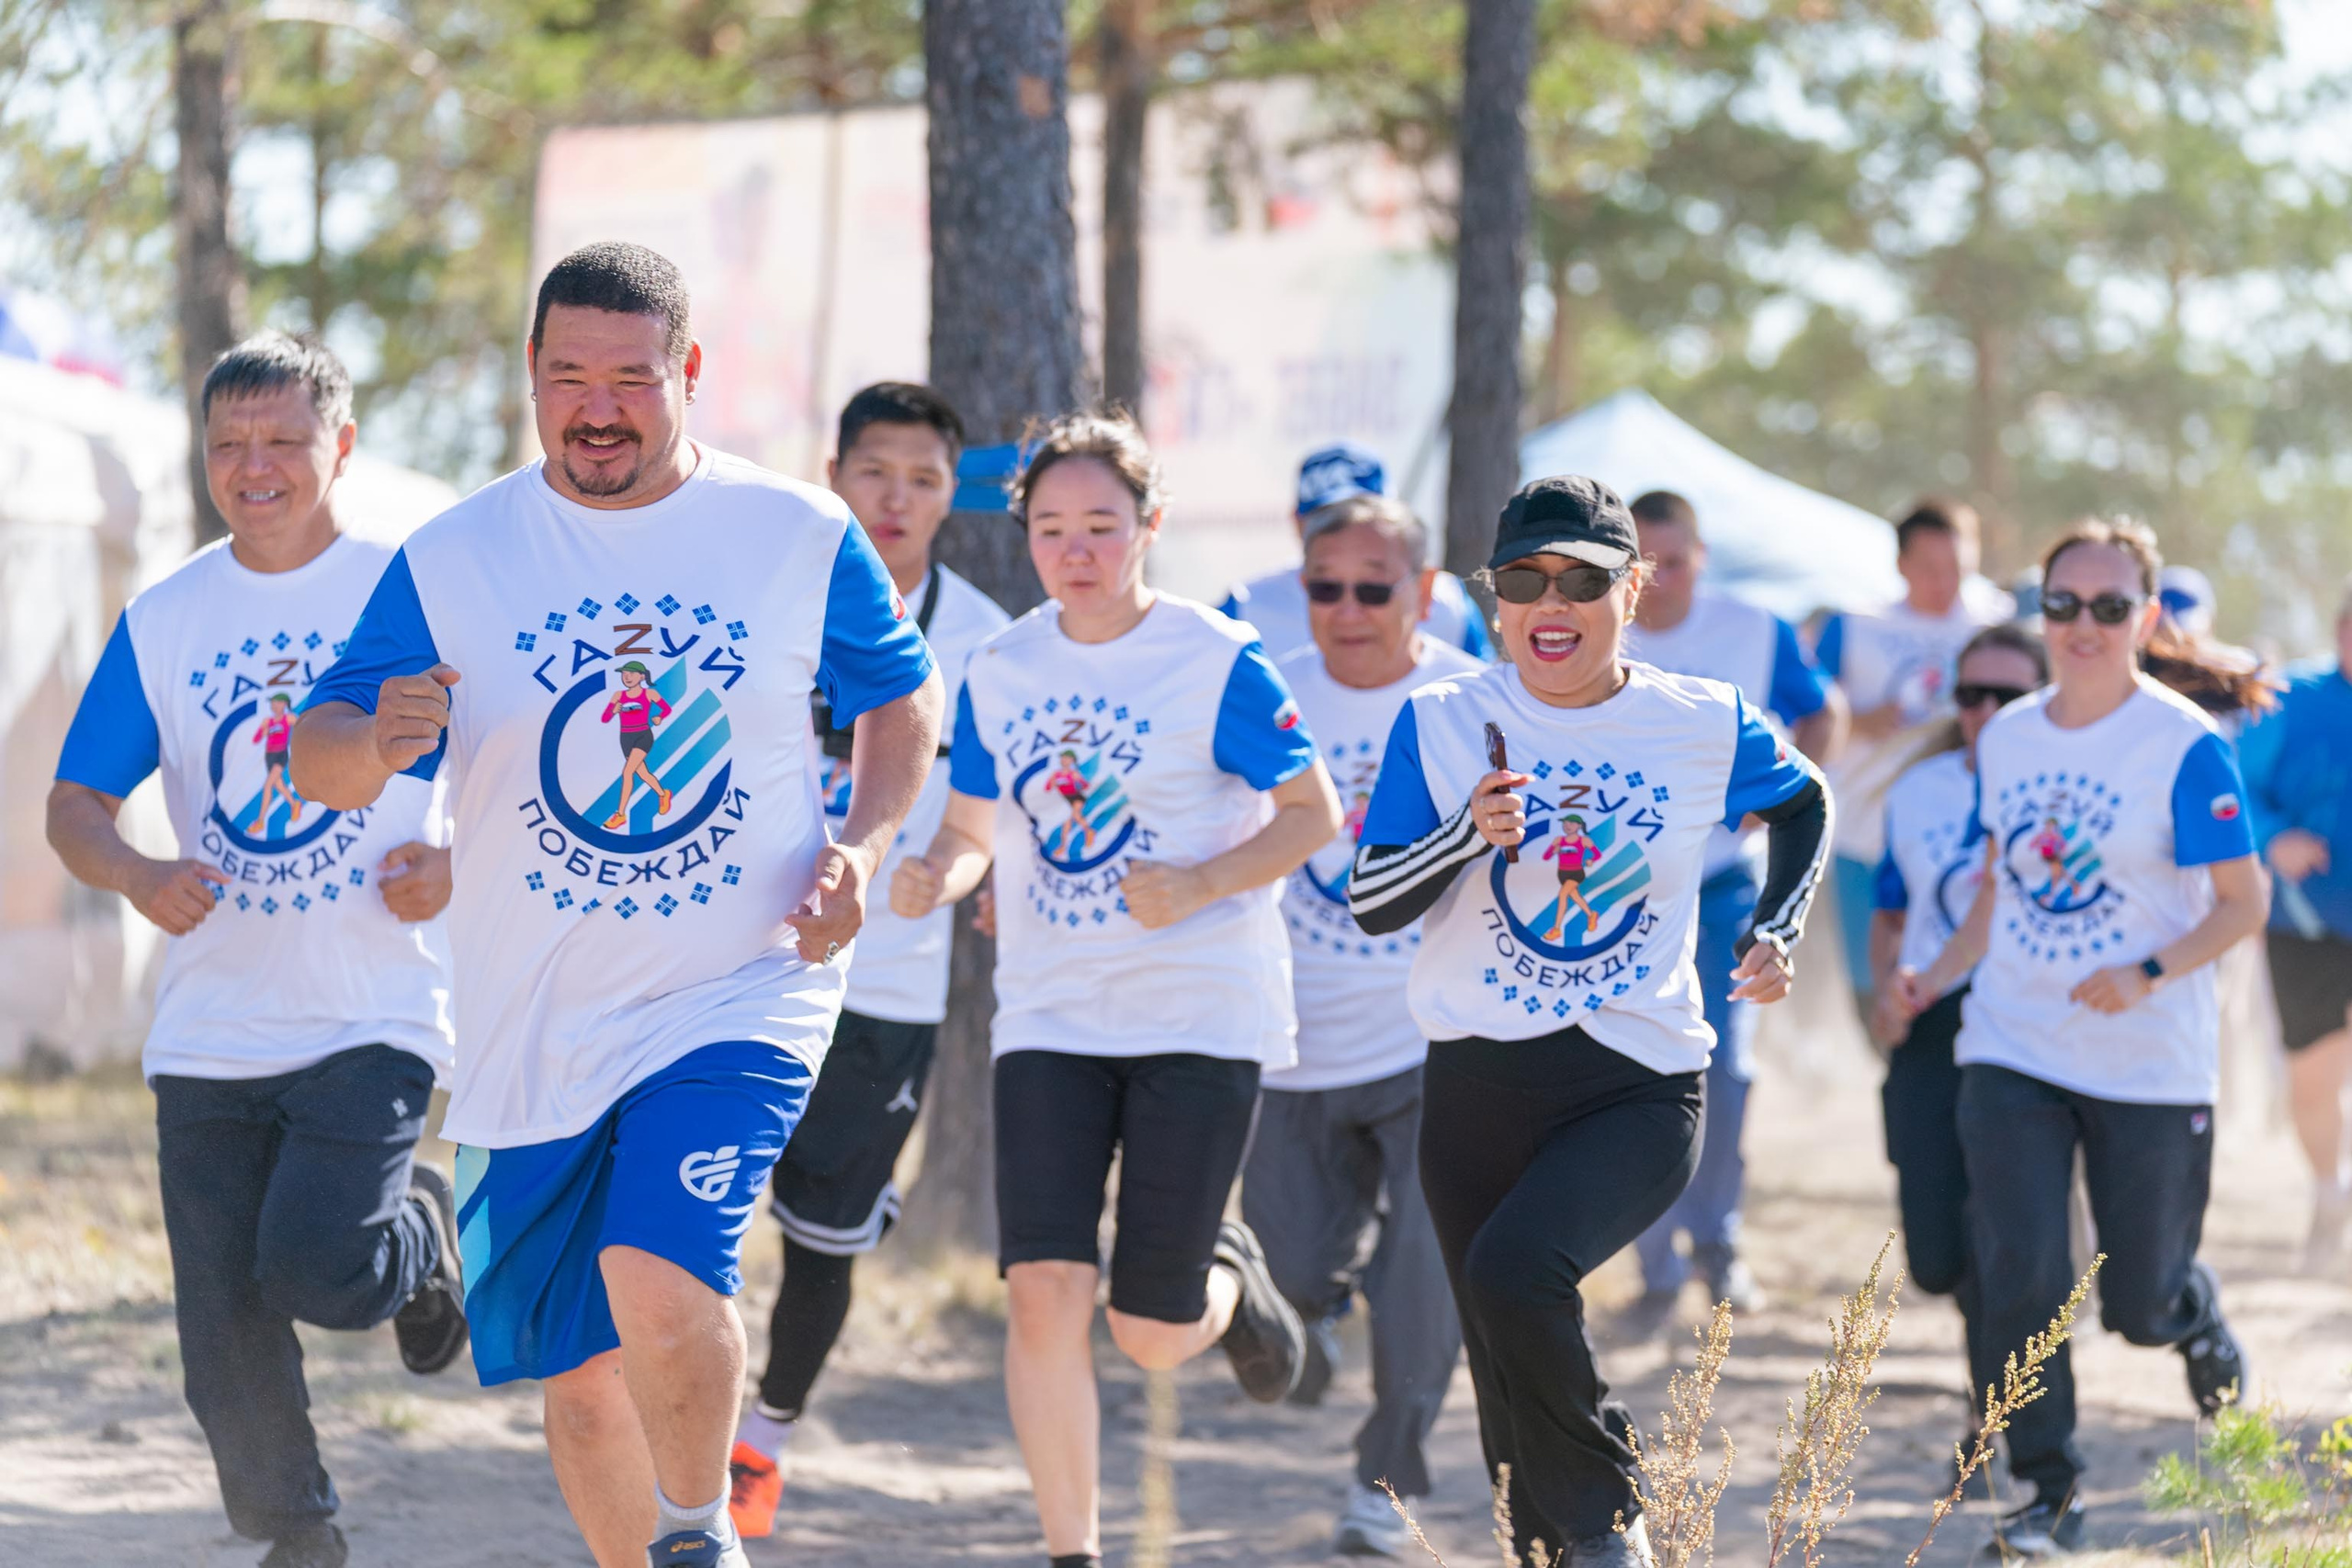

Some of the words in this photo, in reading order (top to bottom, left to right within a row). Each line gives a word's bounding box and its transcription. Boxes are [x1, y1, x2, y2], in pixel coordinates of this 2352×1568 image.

[202, 659, 330, 720] ГАZУ
[532, 623, 746, 694] ГАZУЙ
[1006, 719, 1143, 774] ГАZУЙ
[201, 805, 374, 886] ОБЕЖДАЙ
[518, 786, 752, 887] ПОБЕЖДАЙ
[1525, 784, 1665, 843] АZУЙ
[1481, 908, 1659, 988] ПОБЕЖДАЙ
